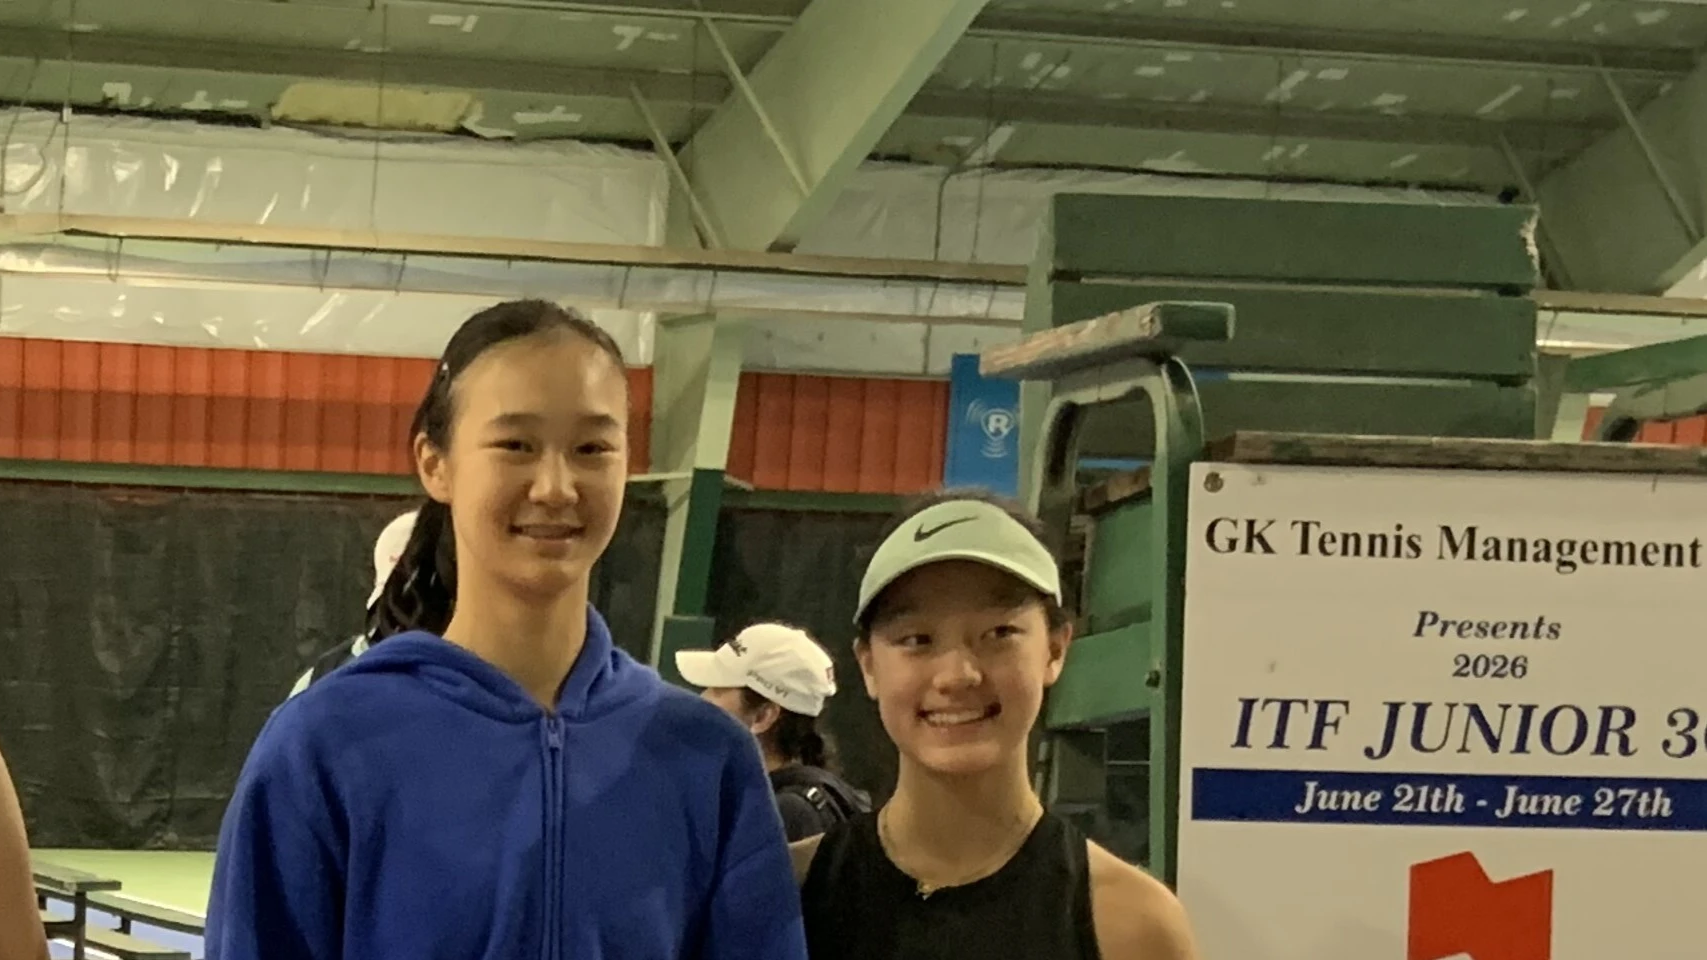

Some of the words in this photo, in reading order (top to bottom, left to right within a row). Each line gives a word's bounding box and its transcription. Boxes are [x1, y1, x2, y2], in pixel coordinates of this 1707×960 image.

[1204, 517, 1277, 555] GK
[1291, 519, 1423, 560] Tennis
[1437, 525, 1704, 574] Management
[1412, 611, 1562, 641] Presents
[1452, 654, 1529, 679] 2026
[1231, 698, 1350, 751] ITF
[1363, 701, 1638, 762] JUNIOR
[1661, 707, 1707, 759] 3
[1295, 781, 1382, 814] June
[1392, 783, 1466, 814] 21th
[1495, 786, 1583, 819] June
[1592, 787, 1673, 818] 27th
